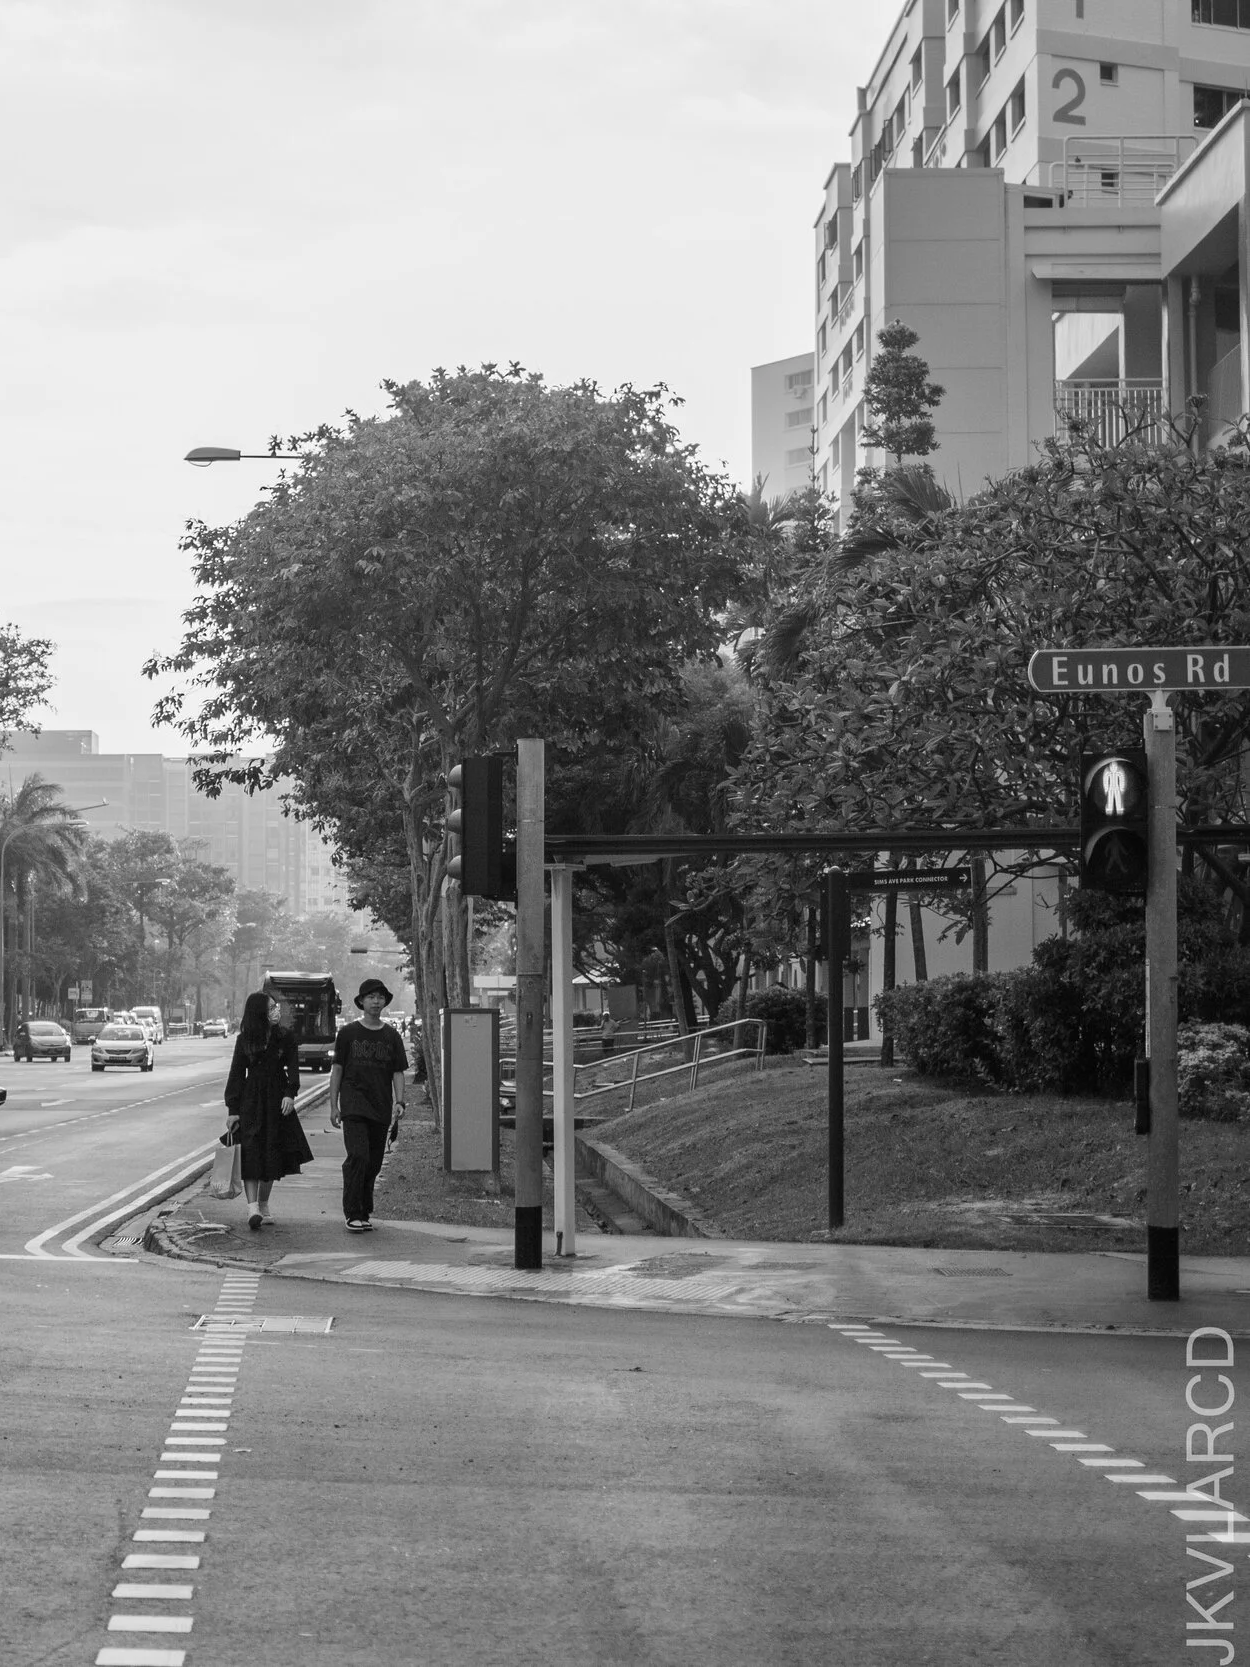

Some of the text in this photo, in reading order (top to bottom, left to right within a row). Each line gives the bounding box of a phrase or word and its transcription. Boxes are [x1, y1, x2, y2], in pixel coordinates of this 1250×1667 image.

[1052, 67, 1086, 126] 2
[1052, 653, 1230, 685] Eunos Rd
